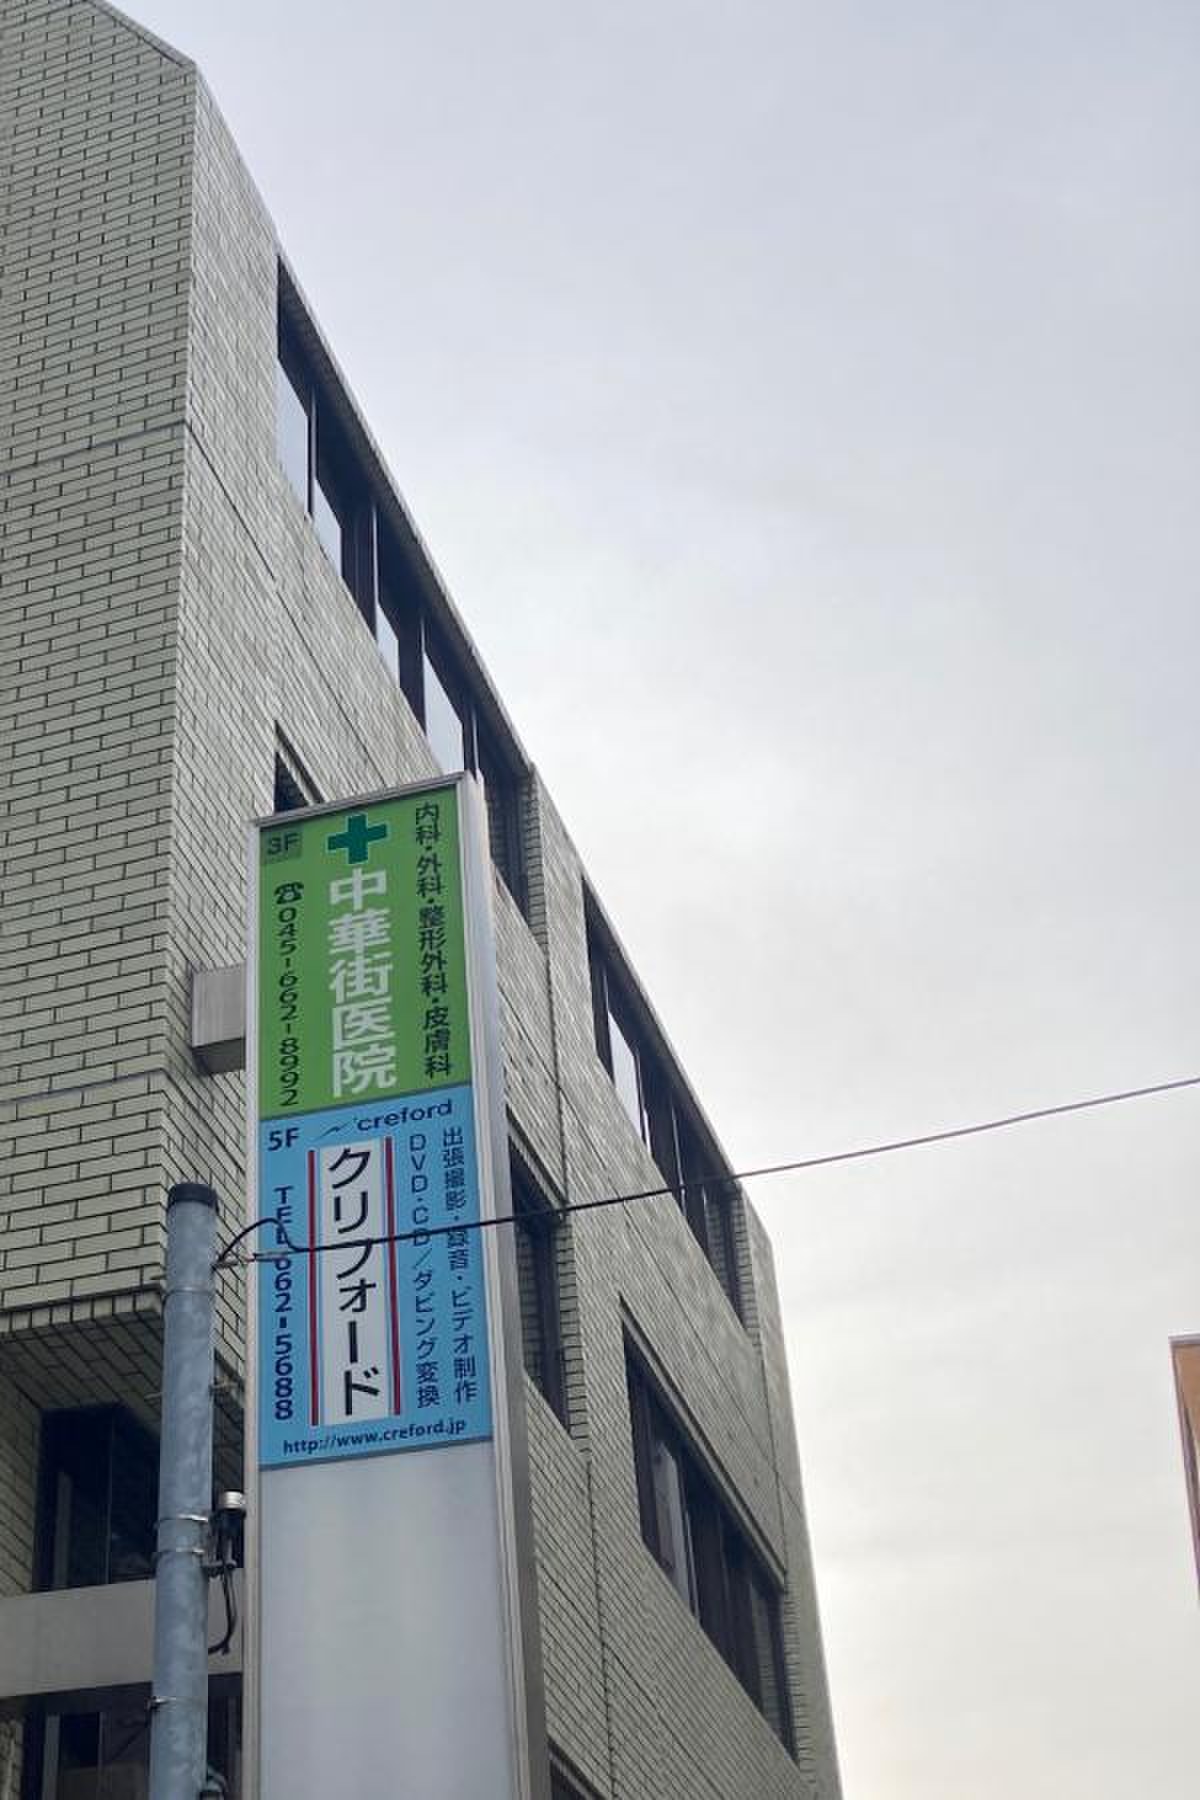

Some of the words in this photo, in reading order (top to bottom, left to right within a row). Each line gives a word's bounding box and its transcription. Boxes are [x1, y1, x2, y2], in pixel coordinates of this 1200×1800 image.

[267, 831, 298, 855] 3F
[327, 866, 397, 1098] 中華街医院
[356, 1099, 452, 1132] creford
[268, 1127, 300, 1151] 5F
[328, 1147, 380, 1416] クリフォード
[283, 1417, 467, 1455] http://www.creford.jp
